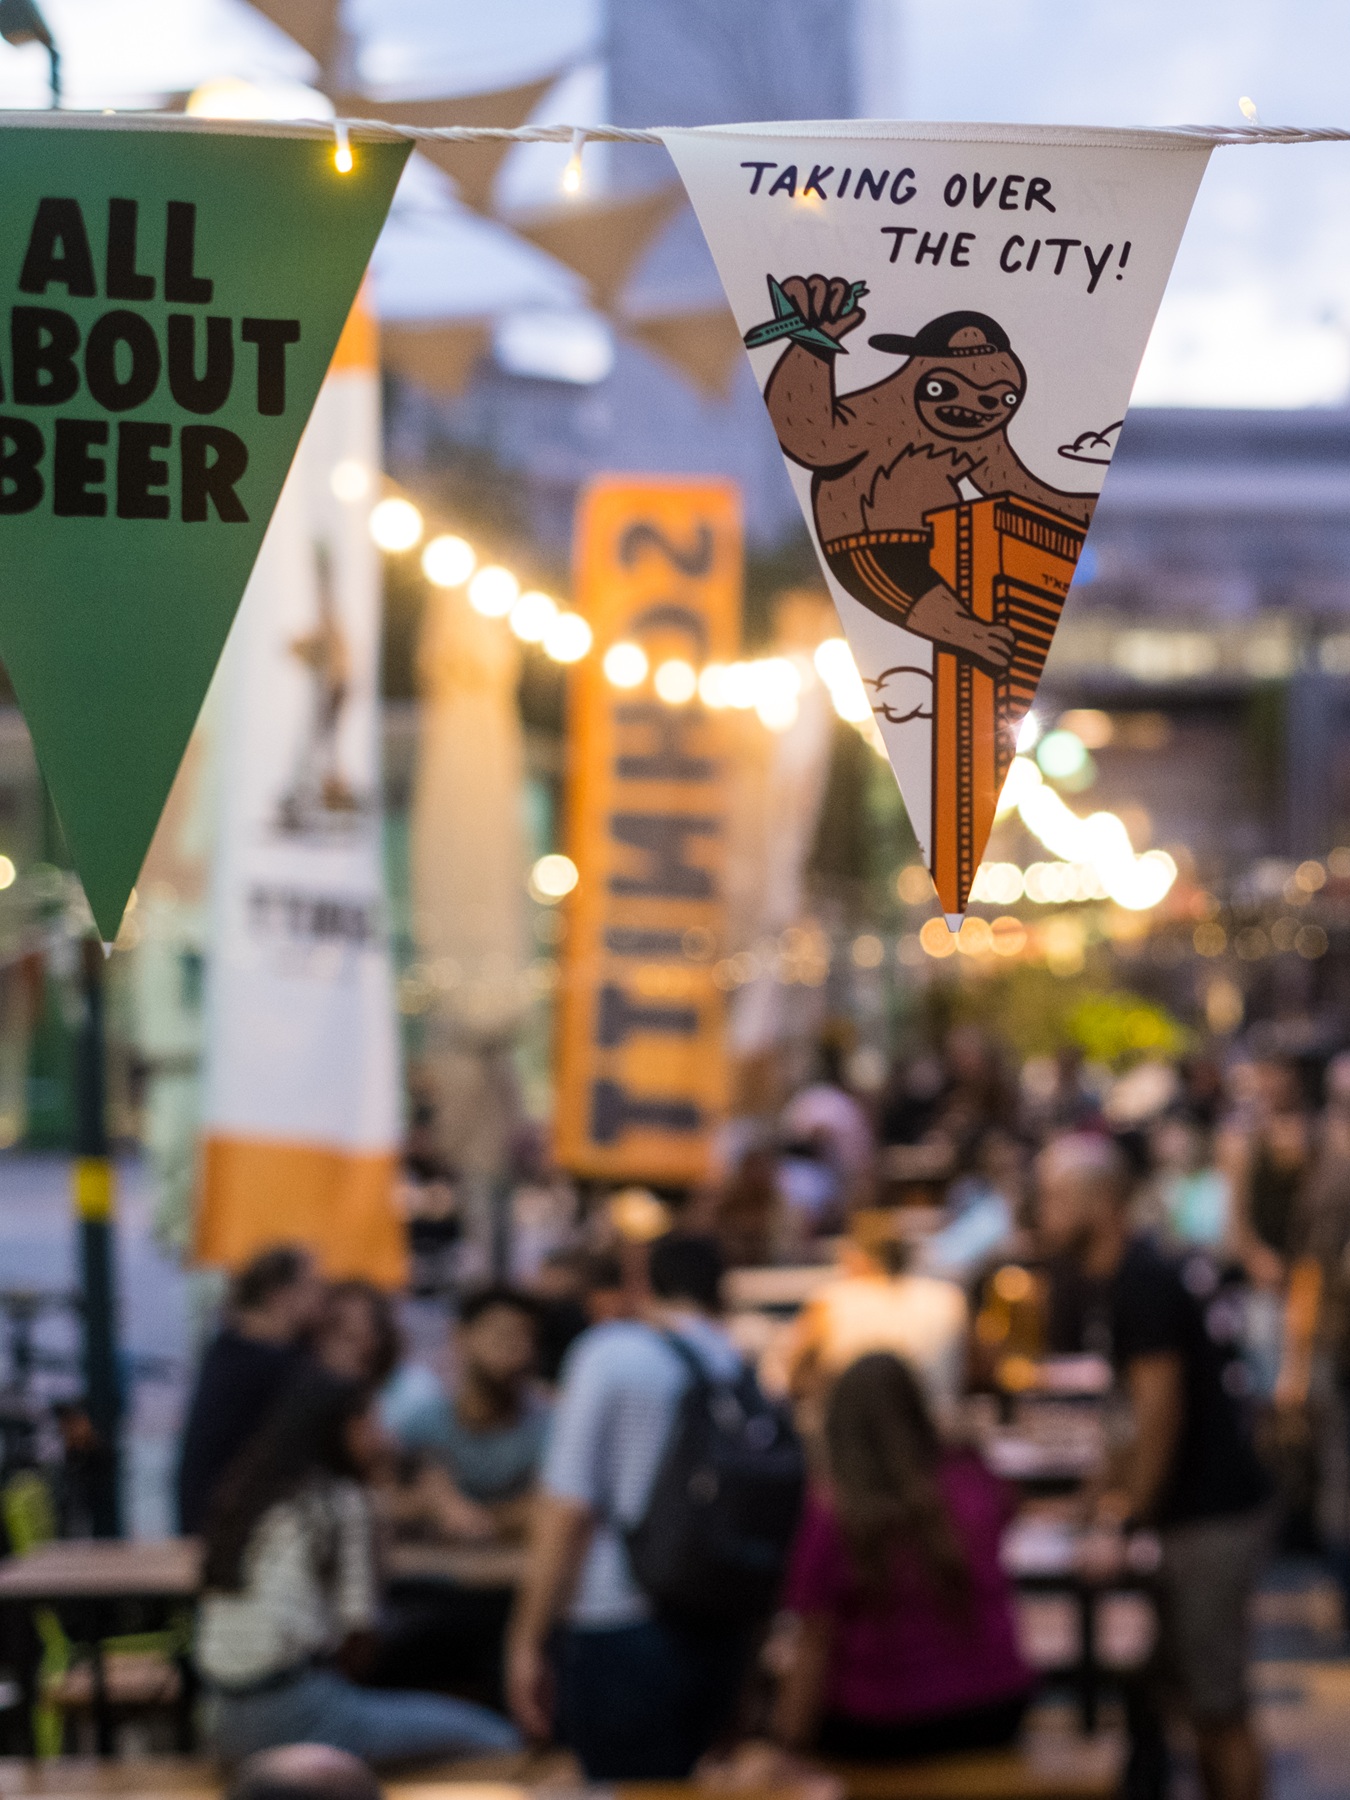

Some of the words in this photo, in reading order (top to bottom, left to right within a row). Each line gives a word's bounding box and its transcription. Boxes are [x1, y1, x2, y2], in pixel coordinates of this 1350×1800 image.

[740, 161, 917, 205] TAKING
[943, 173, 1056, 213] OVER
[18, 197, 214, 305] ALL
[880, 226, 976, 267] THE
[1000, 235, 1132, 294] CITY!
[0, 306, 300, 417] BOUT
[0, 415, 251, 524] BEER
